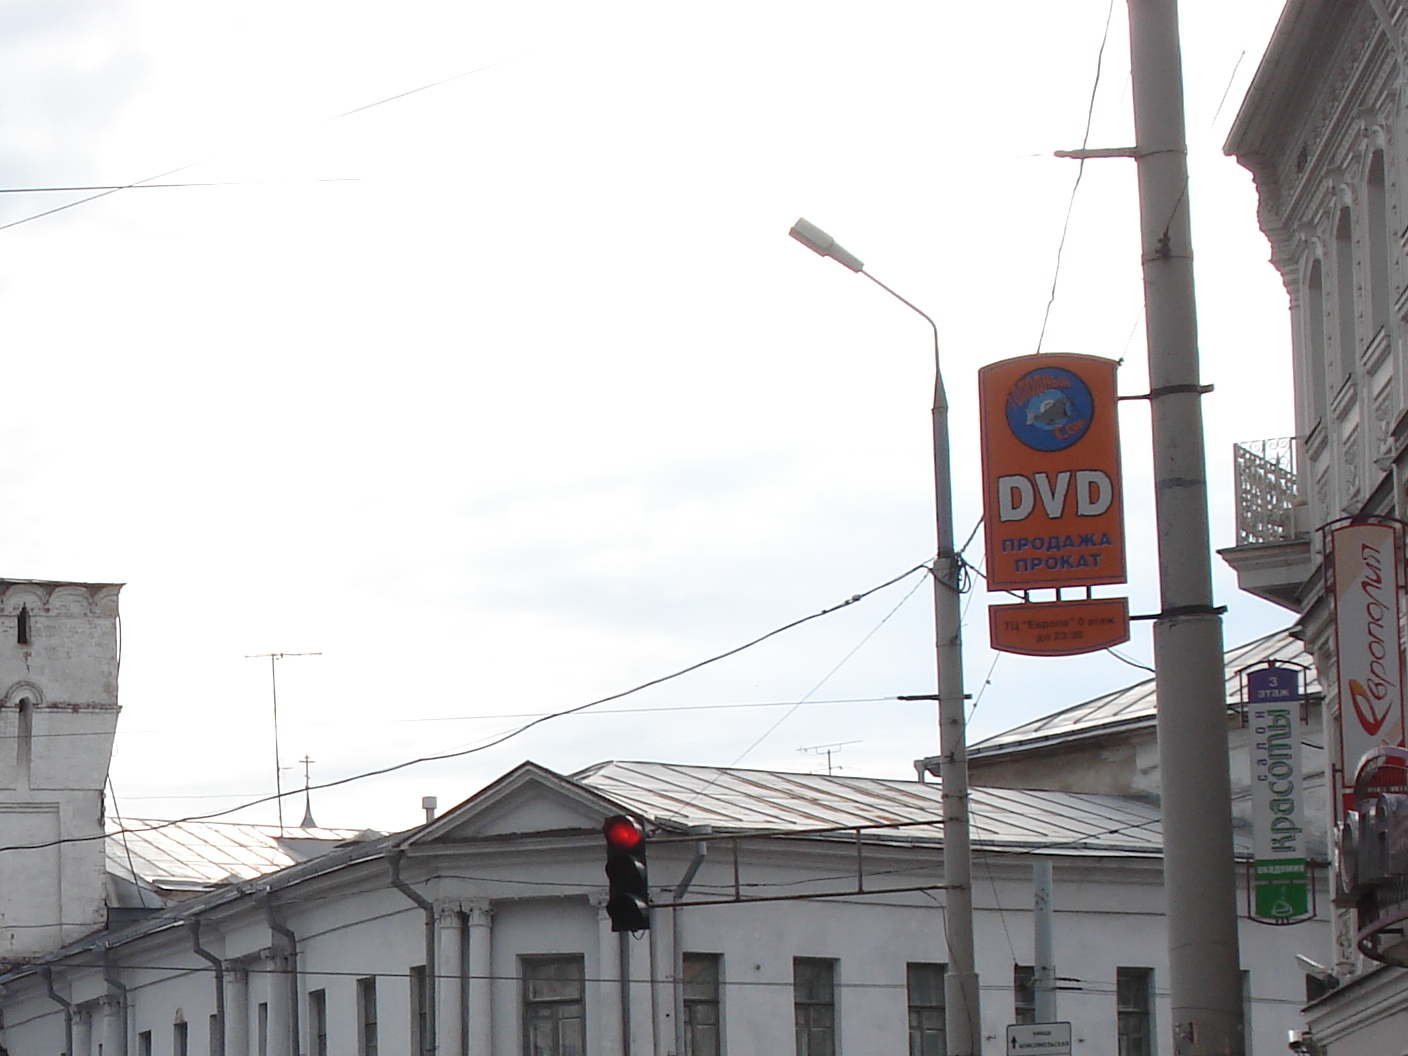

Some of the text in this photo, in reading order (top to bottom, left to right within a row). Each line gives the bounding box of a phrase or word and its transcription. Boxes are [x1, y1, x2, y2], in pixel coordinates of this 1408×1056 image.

[998, 469, 1114, 522] DVD
[1002, 533, 1113, 554] ПРОДАЖА
[1015, 553, 1102, 573] ПРОКАТ
[1268, 676, 1278, 688] 3
